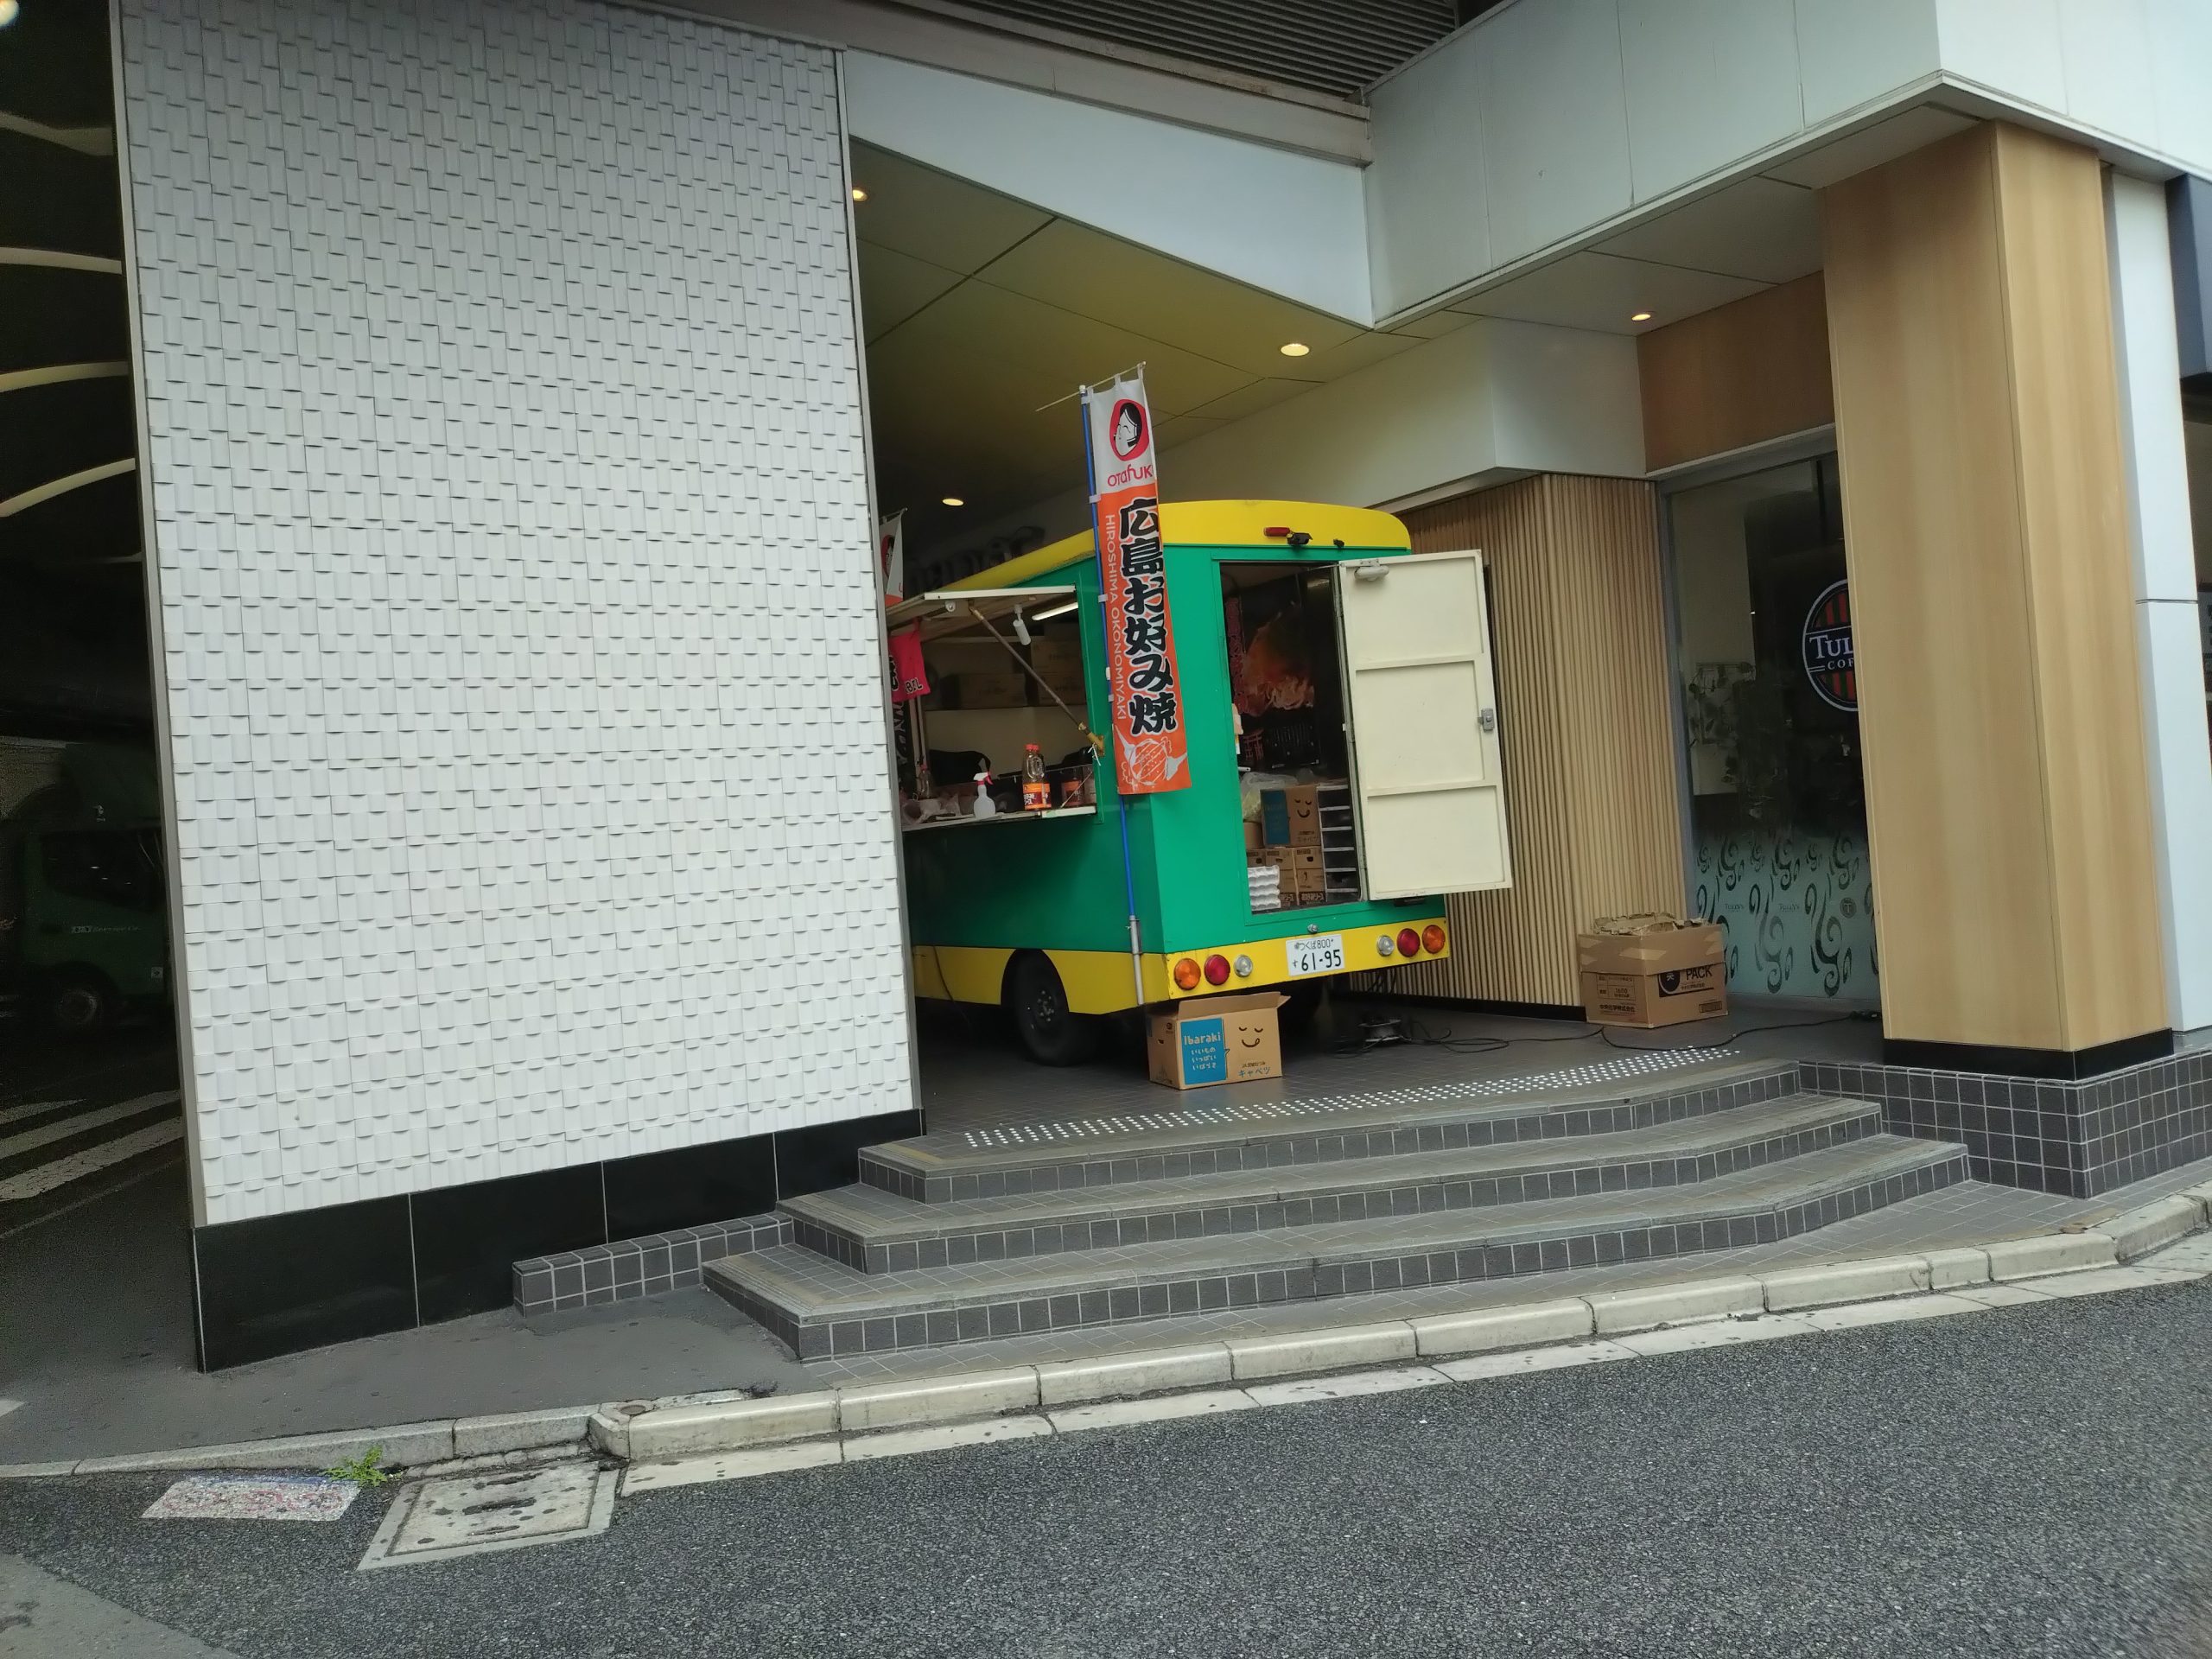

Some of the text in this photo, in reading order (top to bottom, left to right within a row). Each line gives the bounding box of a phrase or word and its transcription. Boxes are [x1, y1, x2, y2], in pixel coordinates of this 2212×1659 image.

[1106, 514, 1127, 720] HIROSHIMA OKONOMIYAKI
[1119, 497, 1178, 734] 広島お好み焼
[1809, 635, 1853, 658] TUL
[1827, 658, 1853, 670] COF
[1301, 949, 1342, 971] 61-95
[1686, 965, 1713, 981] PACK
[1184, 1032, 1221, 1046] Ibaraki
[1238, 1066, 1270, 1078] キャベツ
